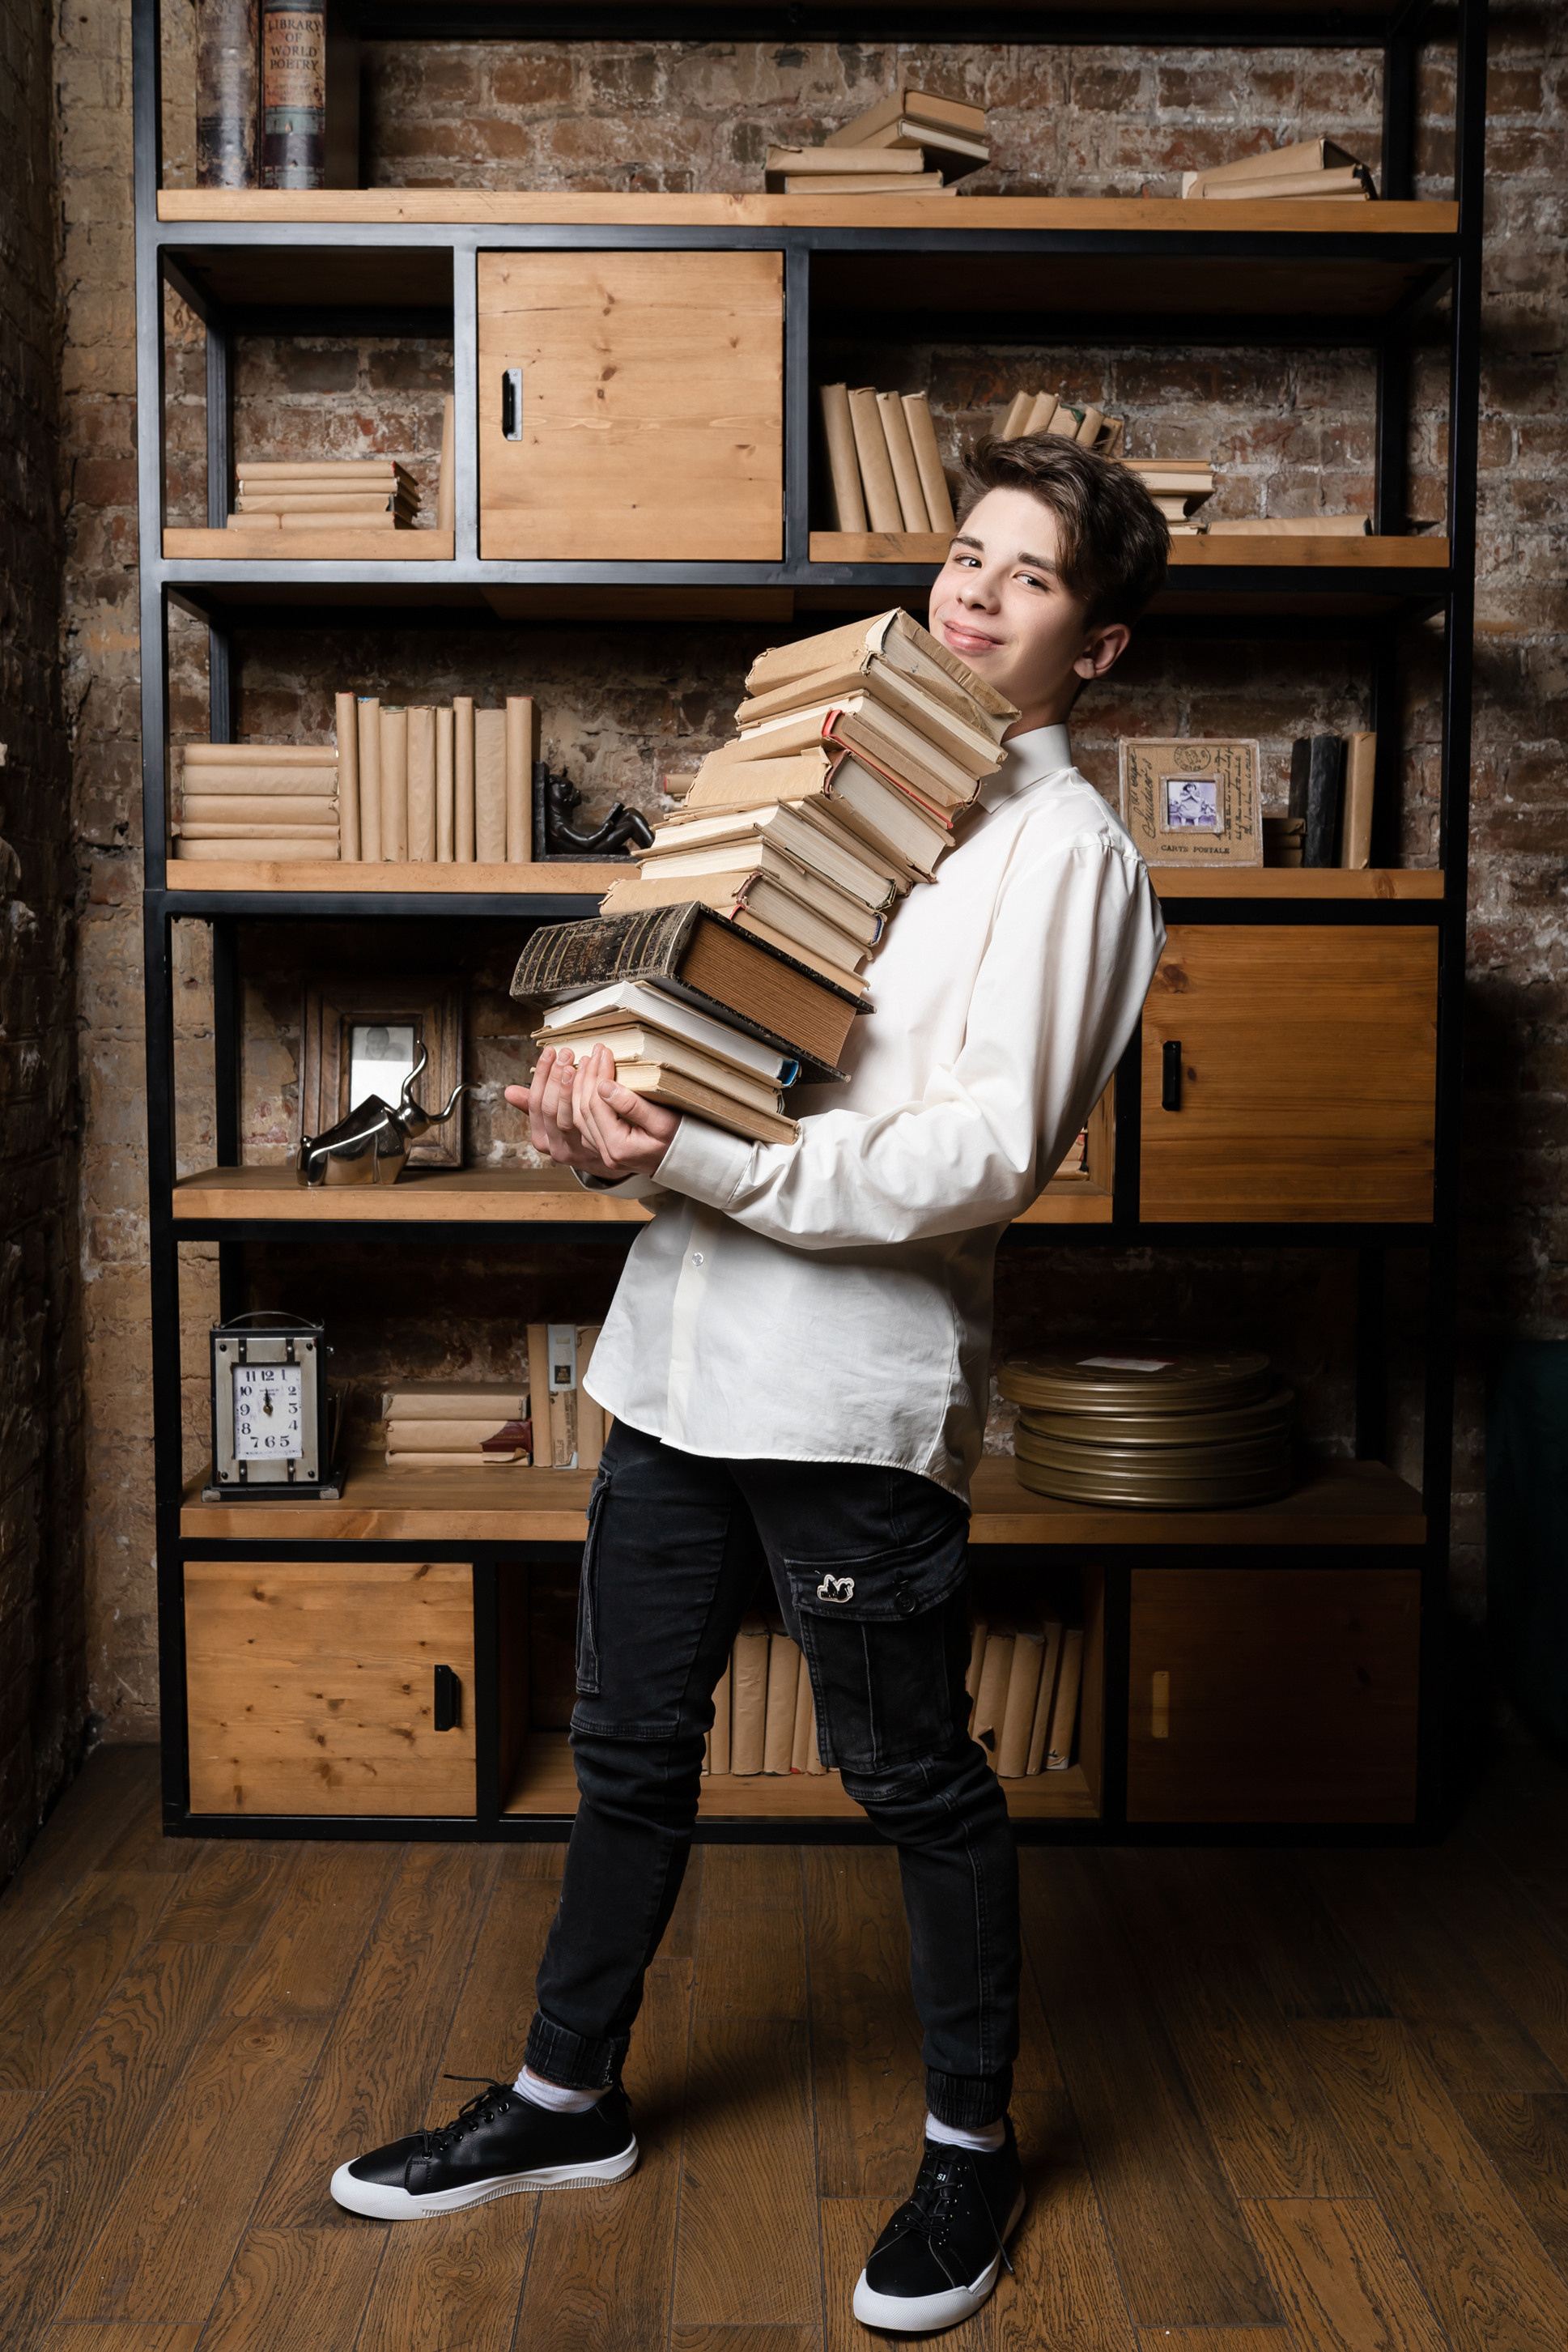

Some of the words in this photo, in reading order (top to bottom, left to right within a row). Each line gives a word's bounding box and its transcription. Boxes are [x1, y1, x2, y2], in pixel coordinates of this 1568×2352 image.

[269, 19, 321, 32] LIBRARY
[286, 32, 303, 43] OF
[271, 45, 317, 57] WORLD
[270, 58, 319, 70] POETRY
[1193, 846, 1230, 854] POSTALE
[246, 1371, 257, 1381] 11
[261, 1370, 274, 1381] 12
[281, 1369, 286, 1380] 1
[240, 1386, 253, 1396] 10
[288, 1386, 297, 1396] 2
[240, 1404, 250, 1416] 9
[288, 1402, 298, 1414] 3
[241, 1423, 252, 1435] 8
[288, 1419, 299, 1431] 4
[250, 1436, 260, 1448] 7
[265, 1435, 275, 1448] 6
[279, 1435, 290, 1448] 5
